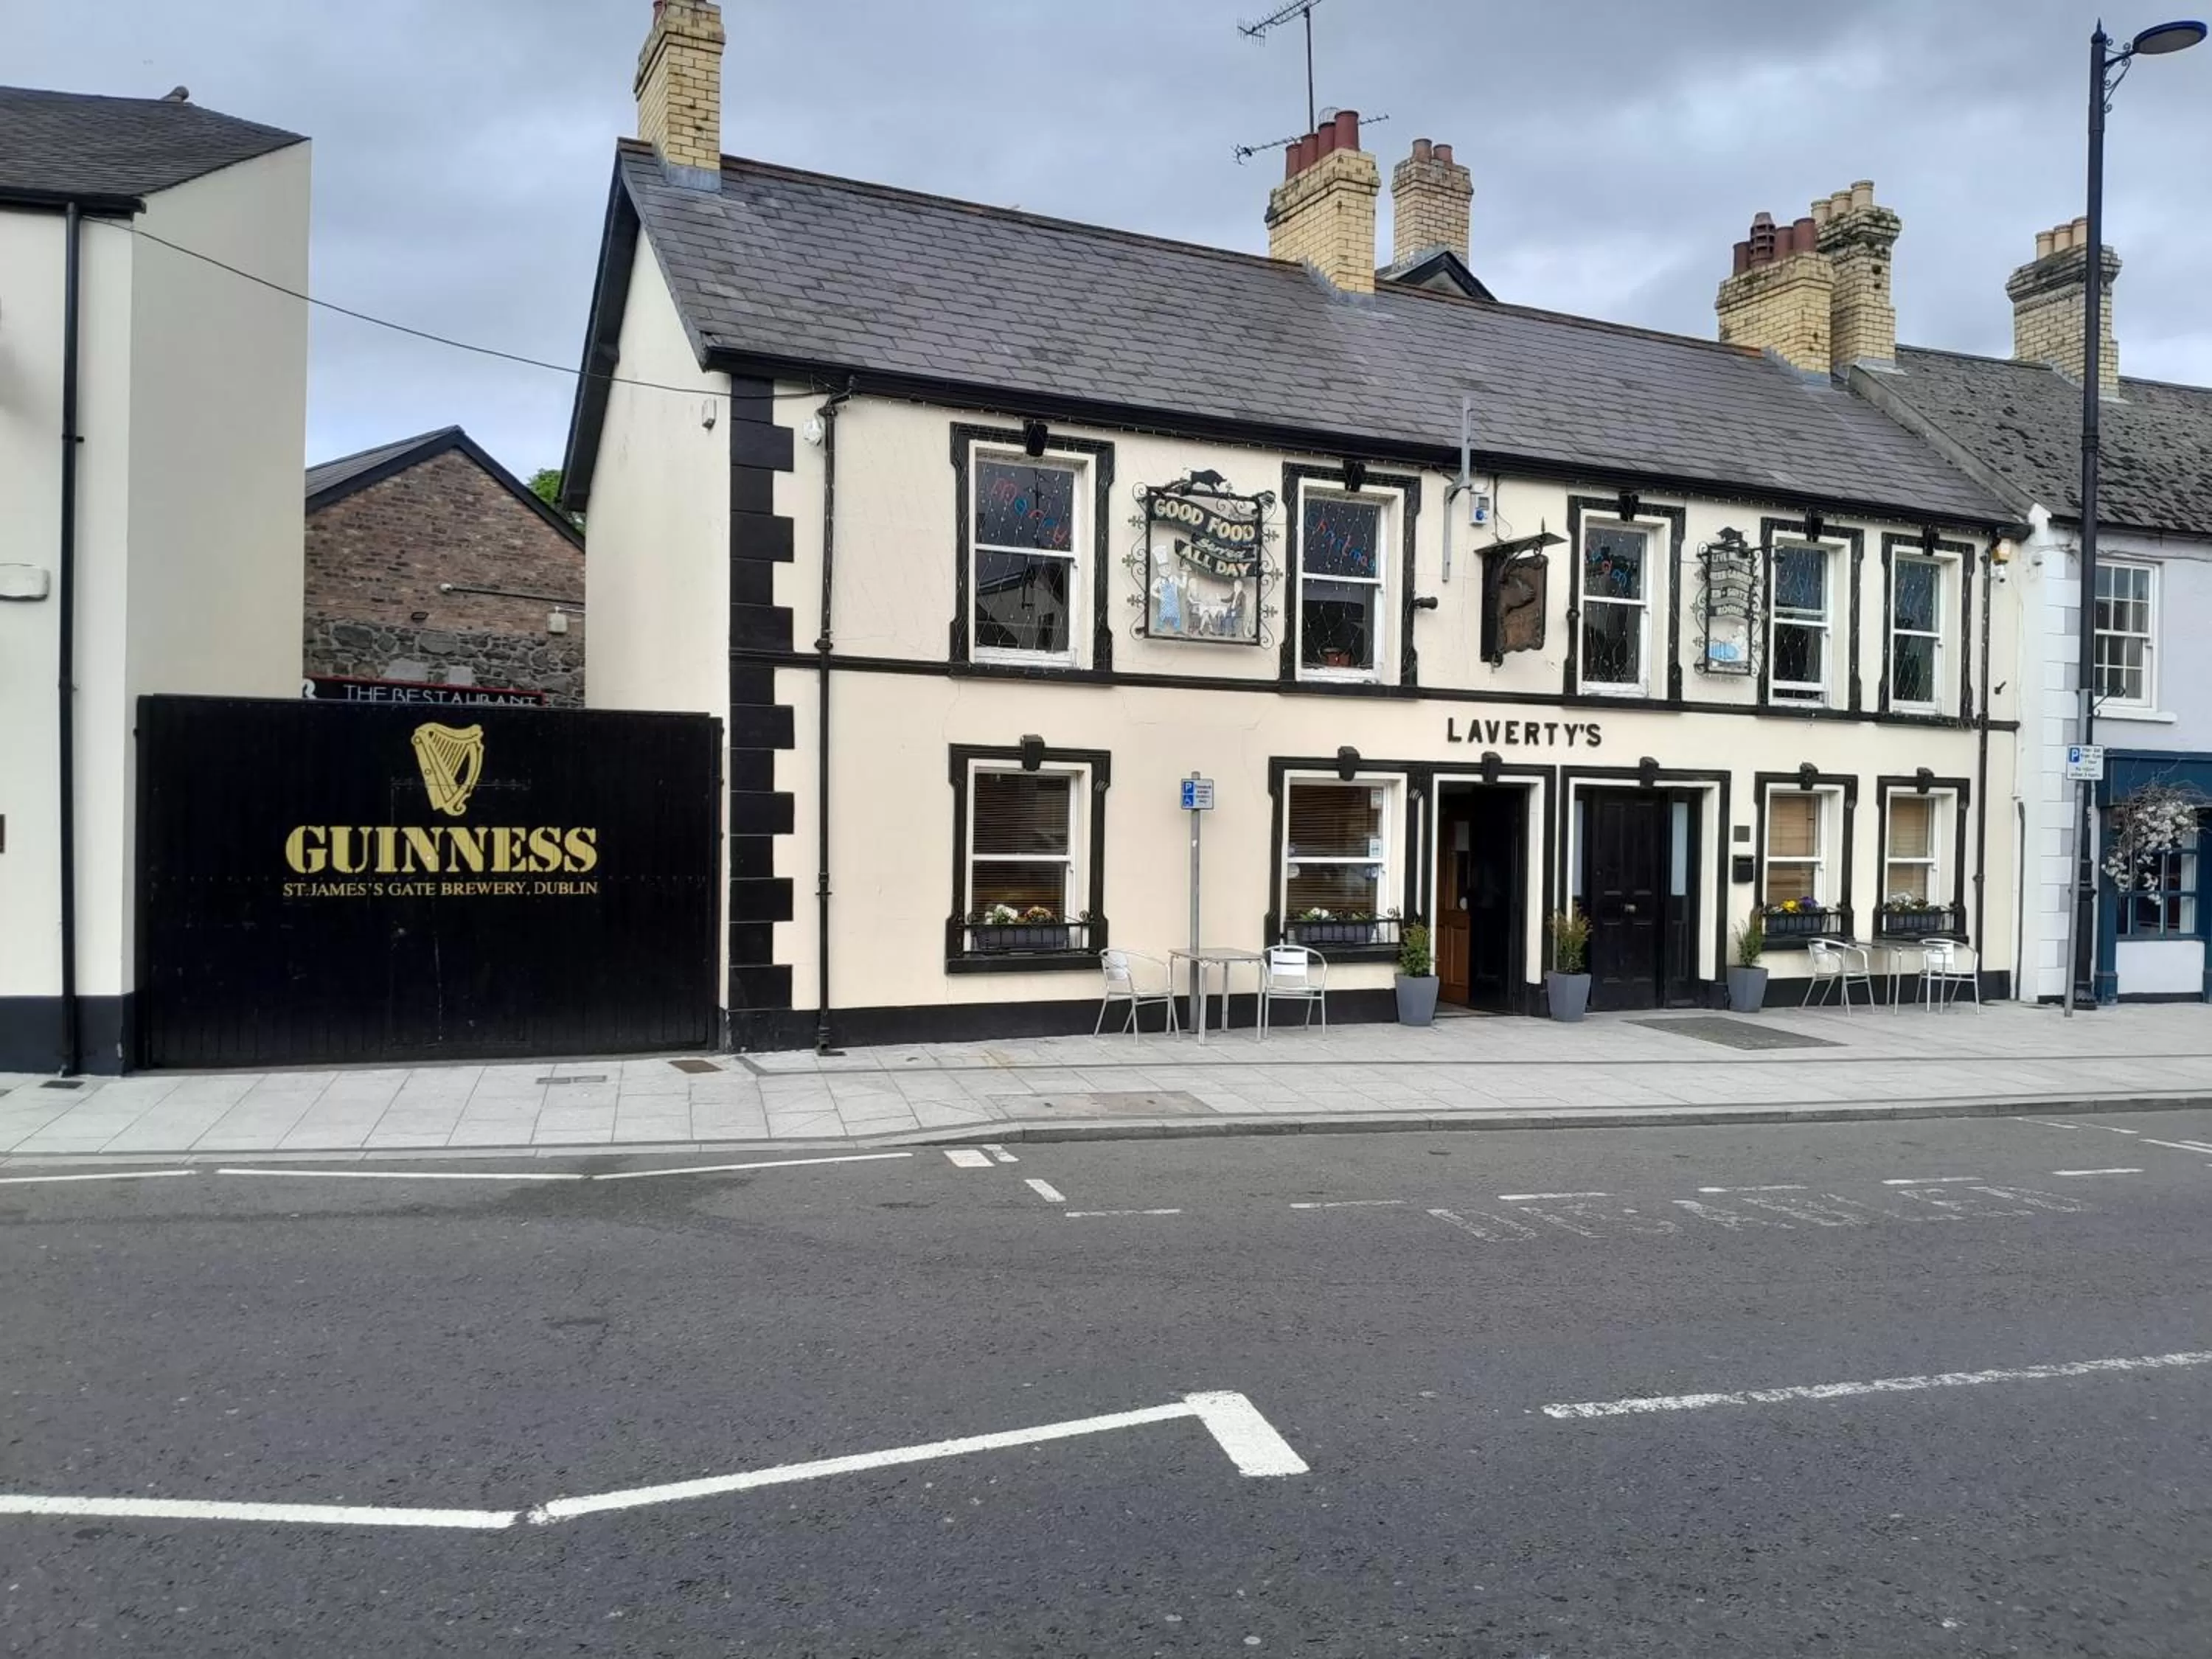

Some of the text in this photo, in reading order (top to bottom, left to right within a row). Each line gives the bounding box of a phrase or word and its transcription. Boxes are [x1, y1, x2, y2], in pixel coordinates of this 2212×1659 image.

[1154, 498, 1255, 542] GOOD FOOD
[1180, 545, 1251, 577] ALL DAY
[343, 684, 386, 701] THE
[1447, 717, 1601, 747] LAVERTY'S
[285, 825, 598, 874] GUINNESS
[388, 883, 437, 896] GATE
[534, 882, 598, 894] DUBLIN
